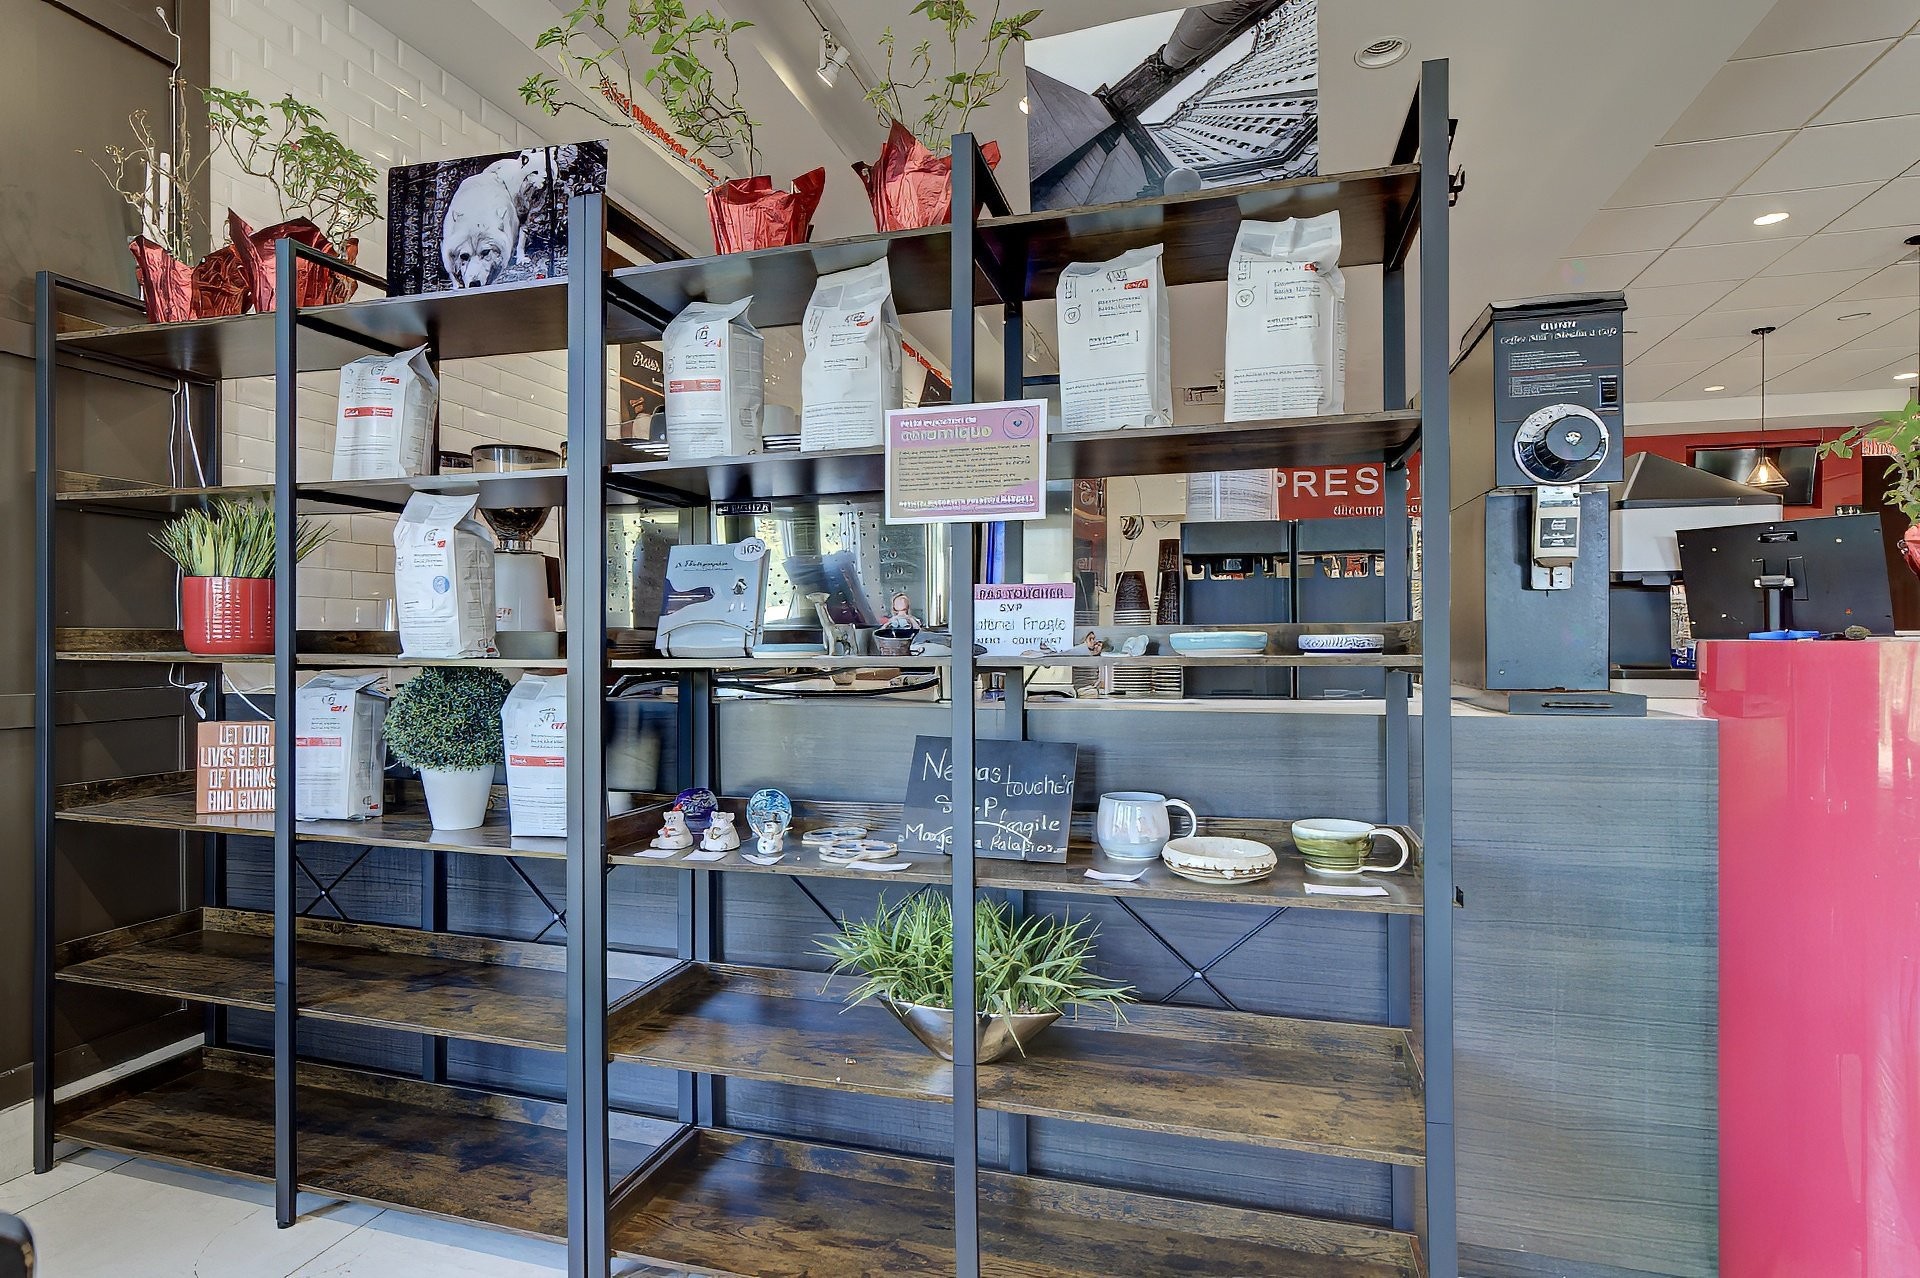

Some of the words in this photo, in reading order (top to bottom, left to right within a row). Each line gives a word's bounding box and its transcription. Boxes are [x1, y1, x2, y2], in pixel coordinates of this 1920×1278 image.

[999, 603, 1023, 612] SVP
[220, 725, 238, 745] LET
[243, 725, 270, 745] OUR
[200, 746, 236, 767] LIVES
[238, 746, 256, 767] BE
[209, 769, 227, 788] OF
[208, 790, 234, 812] AND
